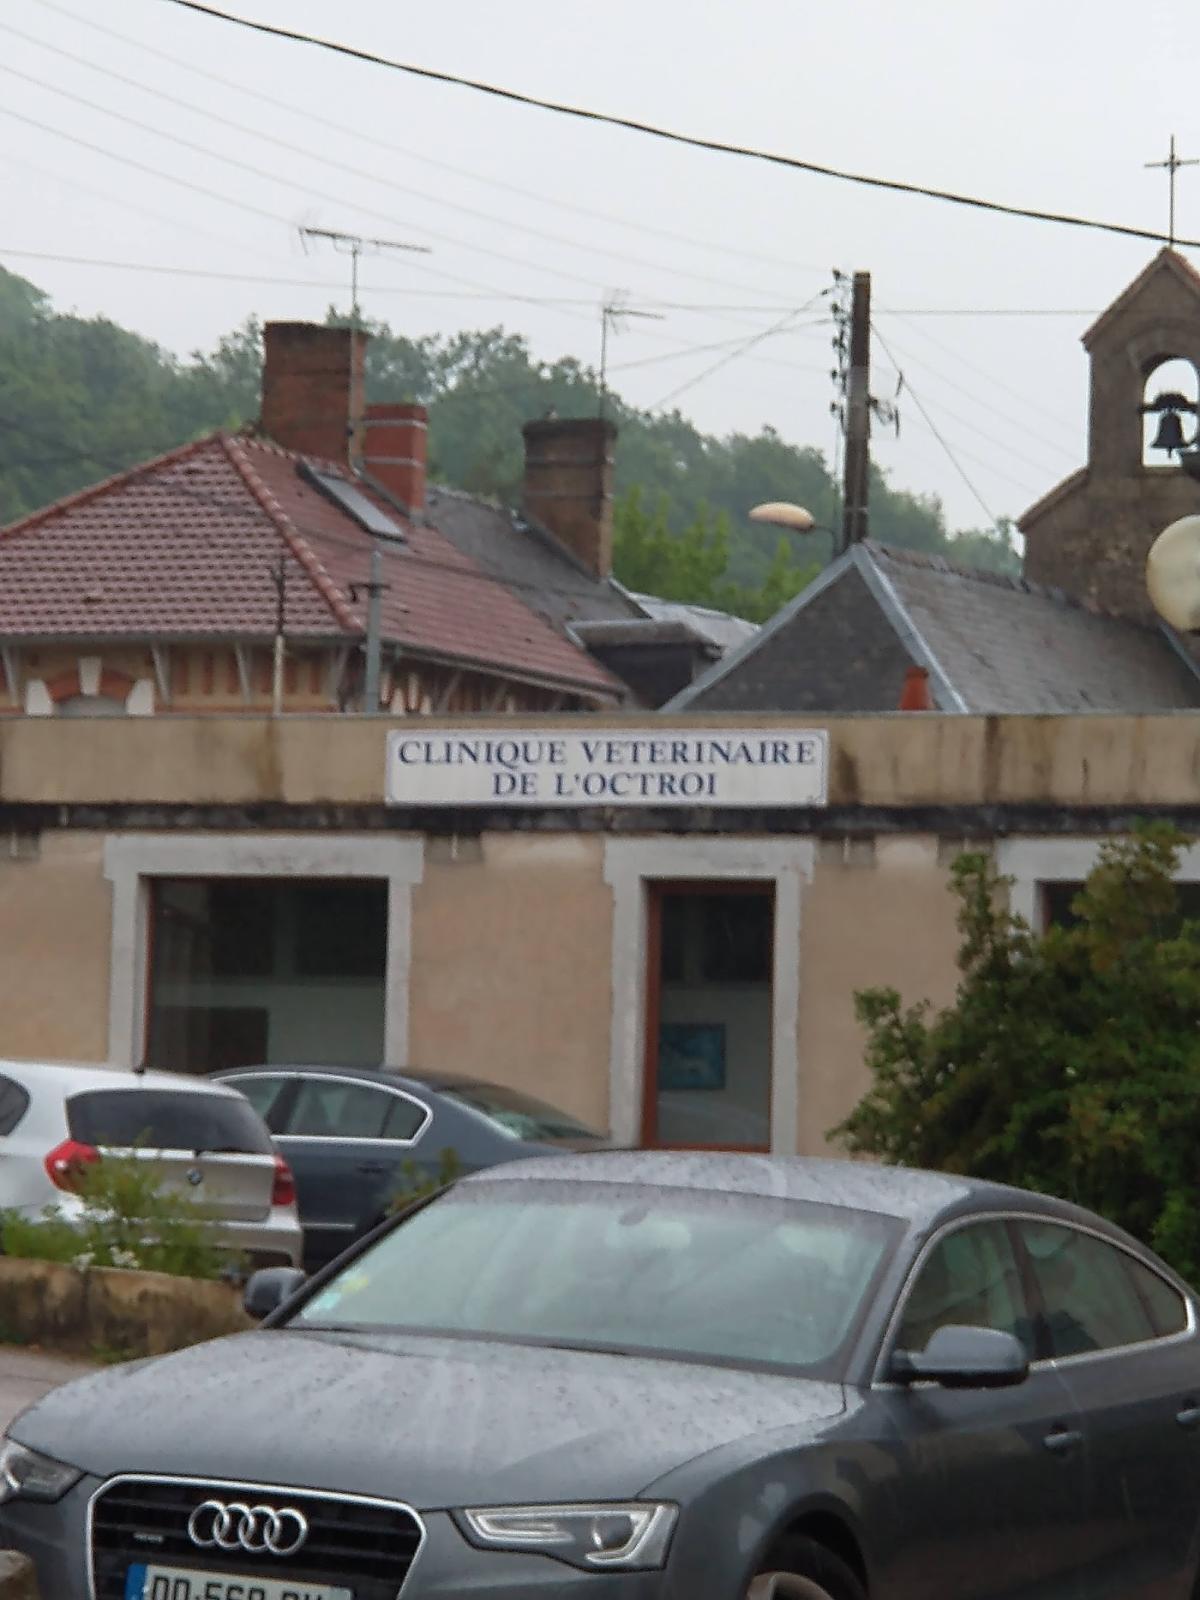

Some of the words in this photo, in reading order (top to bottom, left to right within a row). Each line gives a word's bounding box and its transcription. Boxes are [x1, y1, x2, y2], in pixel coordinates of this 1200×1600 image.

[398, 740, 566, 769] CLINIQUE
[583, 740, 815, 764] VETERINAIRE
[493, 772, 537, 796] DE
[555, 771, 717, 796] L'OCTROI
